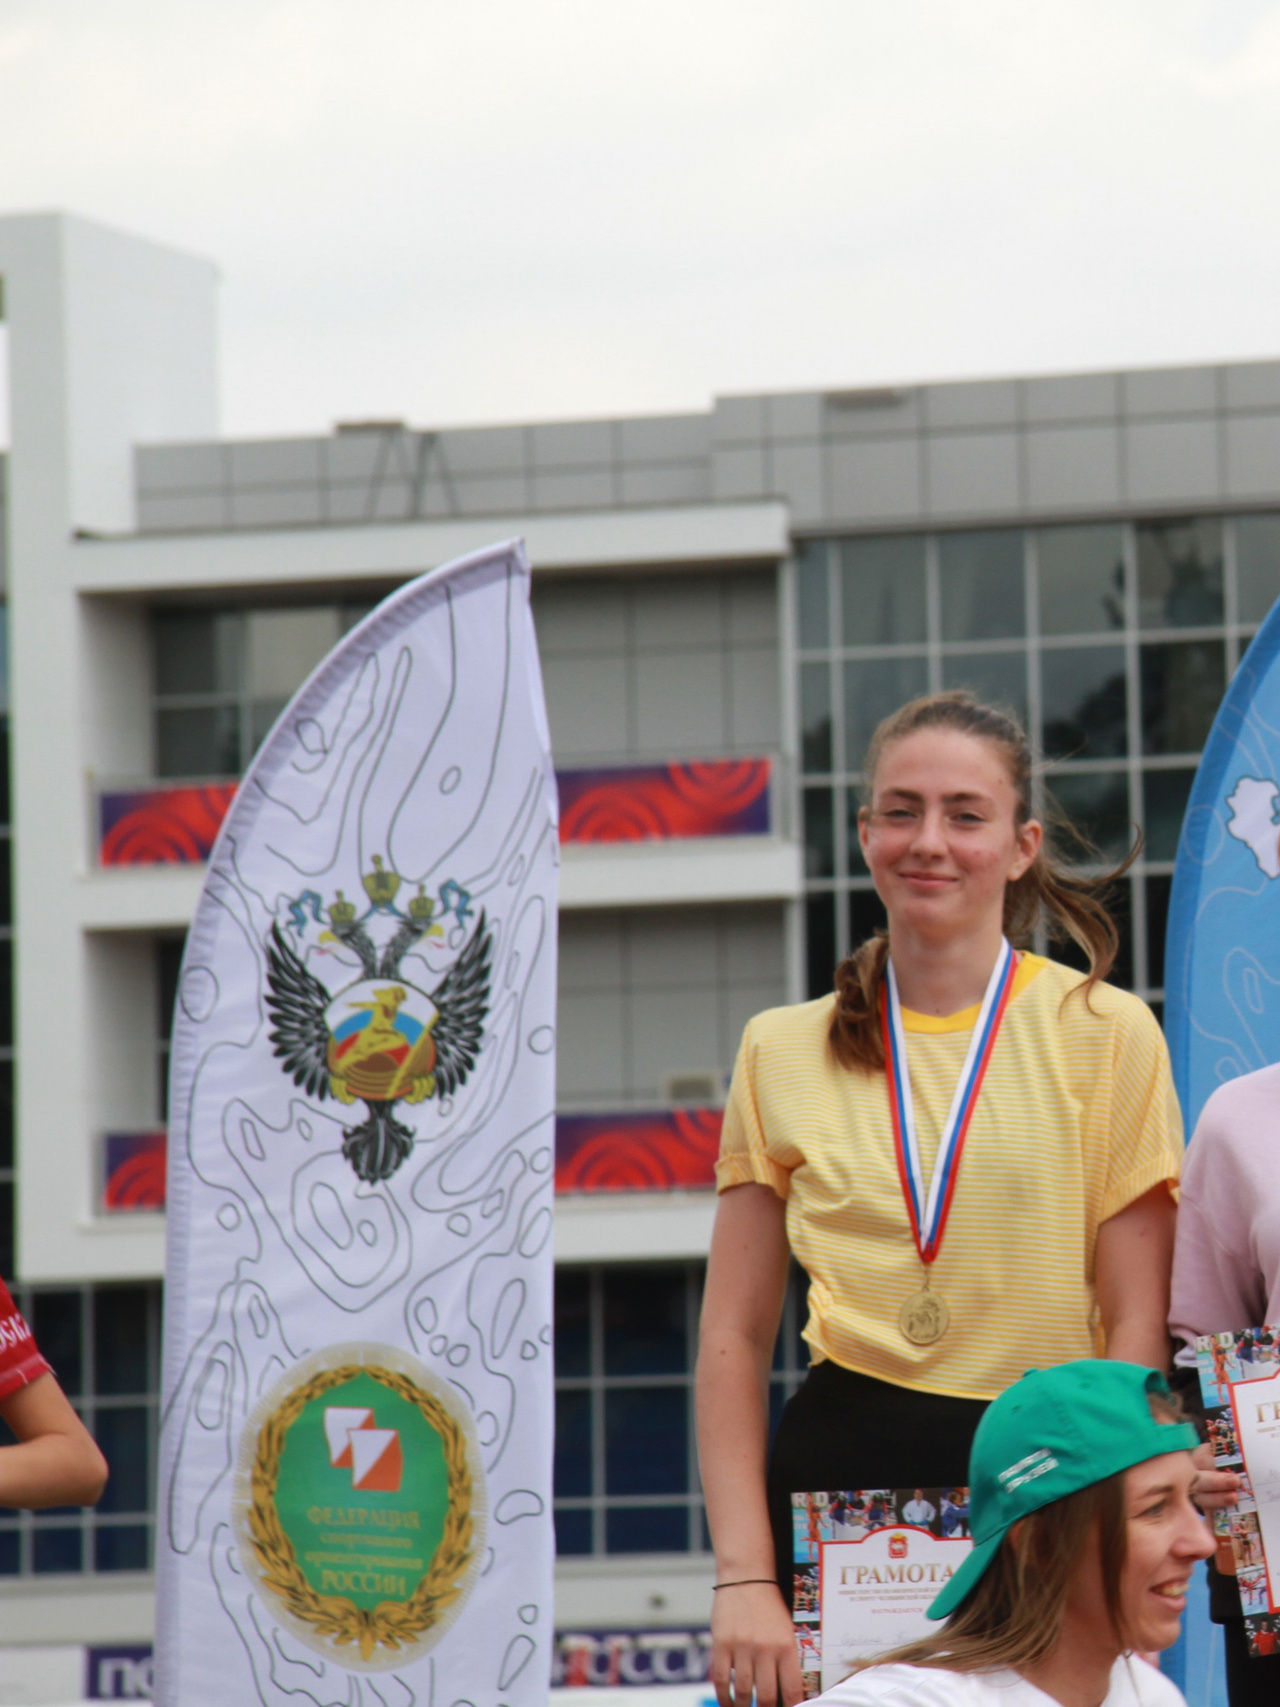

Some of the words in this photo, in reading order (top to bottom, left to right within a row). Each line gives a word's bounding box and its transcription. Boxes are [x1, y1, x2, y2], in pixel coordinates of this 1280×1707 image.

[306, 1505, 420, 1532] ФЕДЕРАЦИЯ
[321, 1569, 406, 1596] РОССИИ
[840, 1562, 956, 1586] ГРАМОТА
